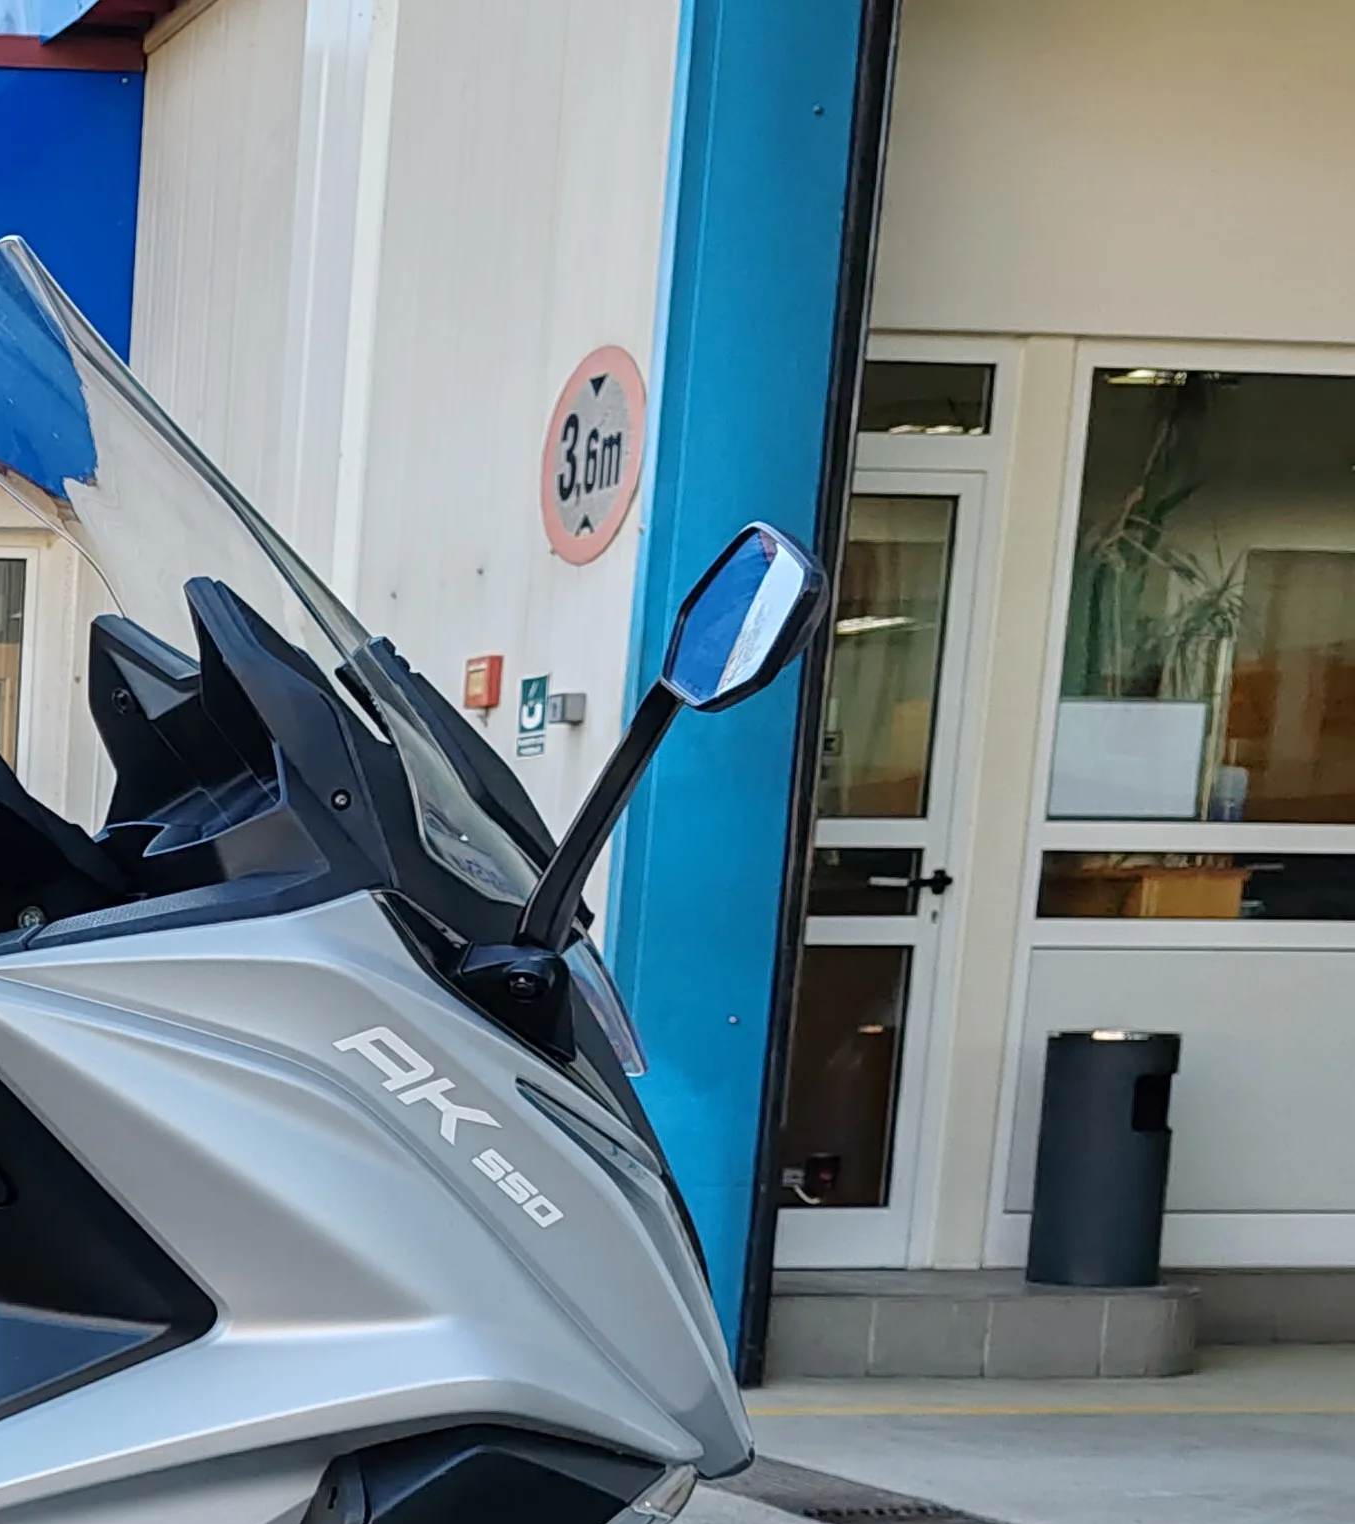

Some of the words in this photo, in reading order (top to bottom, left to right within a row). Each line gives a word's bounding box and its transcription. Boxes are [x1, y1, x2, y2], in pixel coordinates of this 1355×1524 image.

[558, 413, 621, 506] 3,6m
[332, 1026, 502, 1146] AK
[471, 1148, 564, 1228] 550
